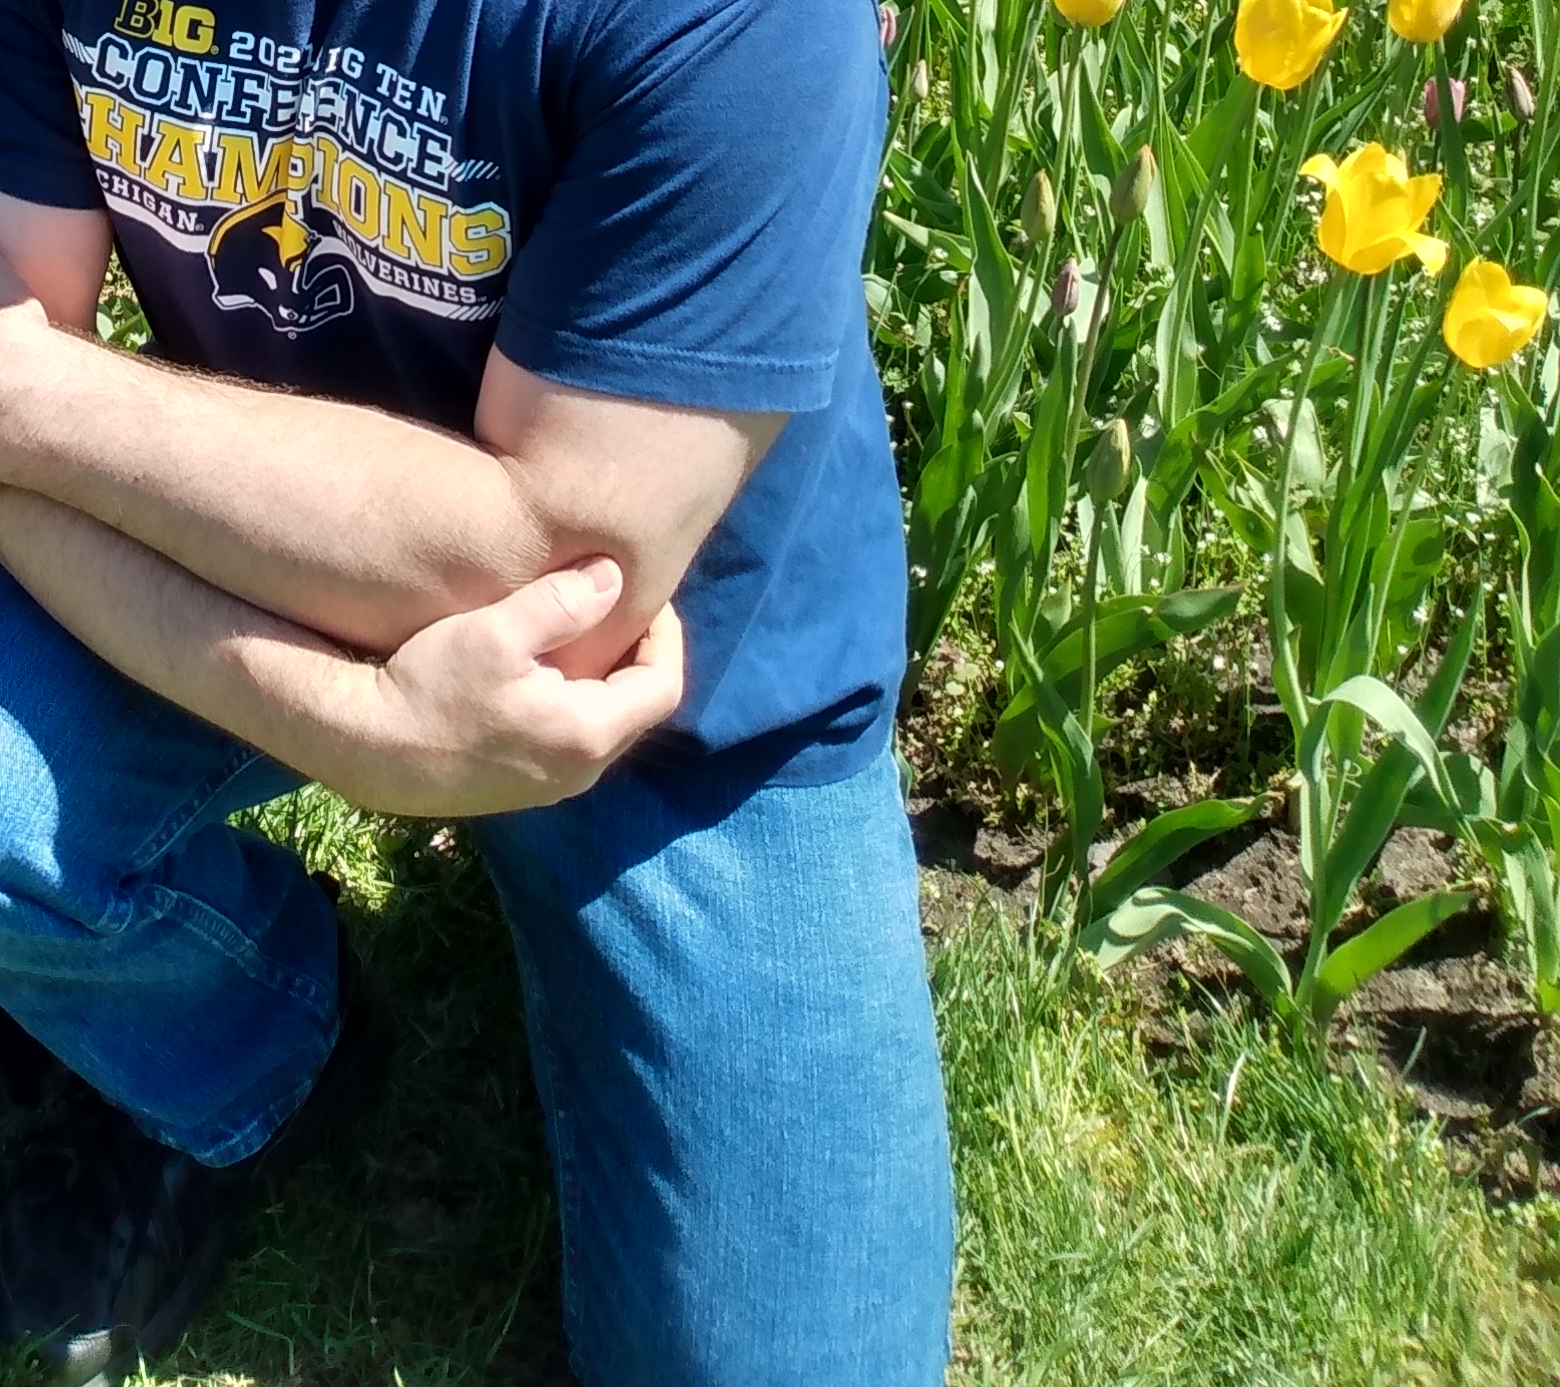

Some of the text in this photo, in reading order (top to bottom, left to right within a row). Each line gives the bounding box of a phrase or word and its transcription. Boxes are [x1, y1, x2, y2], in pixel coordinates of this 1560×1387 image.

[93, 31, 453, 191] CONFEENCE
[229, 30, 447, 122] 2021 IG TEN
[72, 80, 513, 280] HAMPIONS
[96, 169, 477, 305] CHIGAN WOLVERINES
